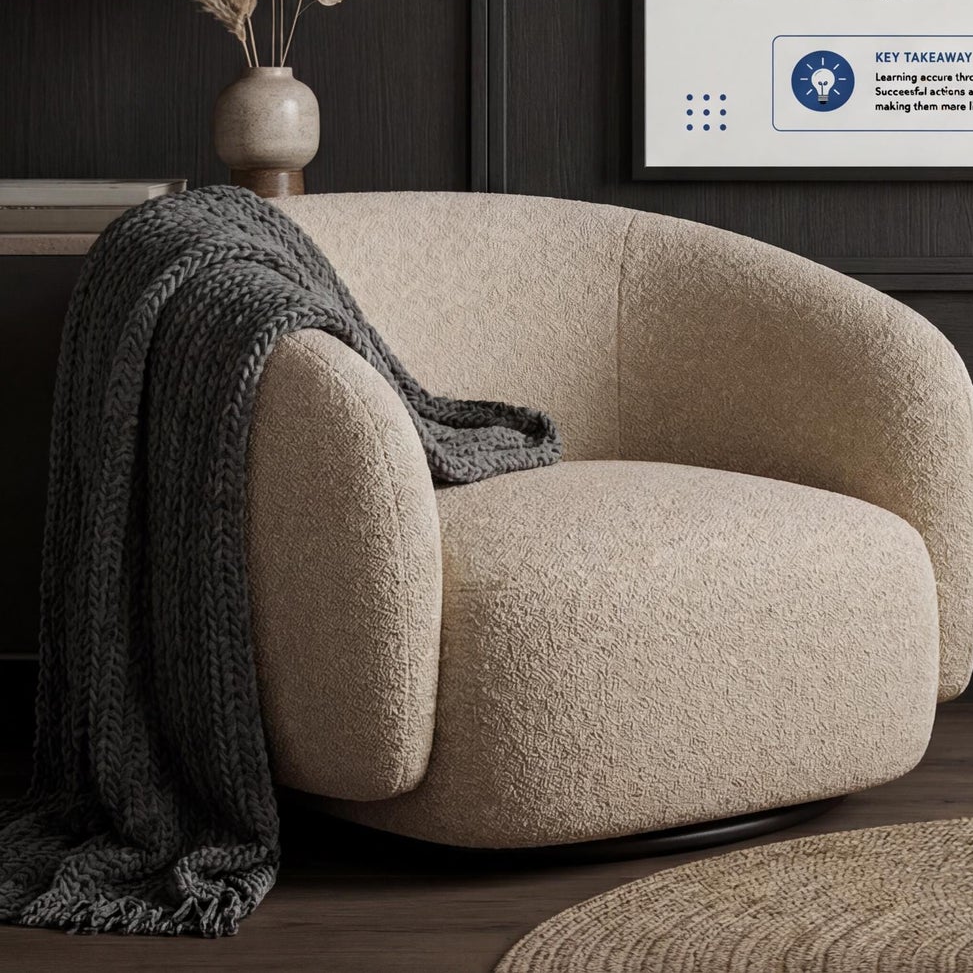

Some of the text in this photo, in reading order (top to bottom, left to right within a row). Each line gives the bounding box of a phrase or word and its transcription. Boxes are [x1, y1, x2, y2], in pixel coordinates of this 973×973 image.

[875, 51, 973, 63] KEY TAKEAWAY
[875, 71, 918, 85] Learning
[875, 100, 911, 114] making
[913, 100, 938, 111] them
